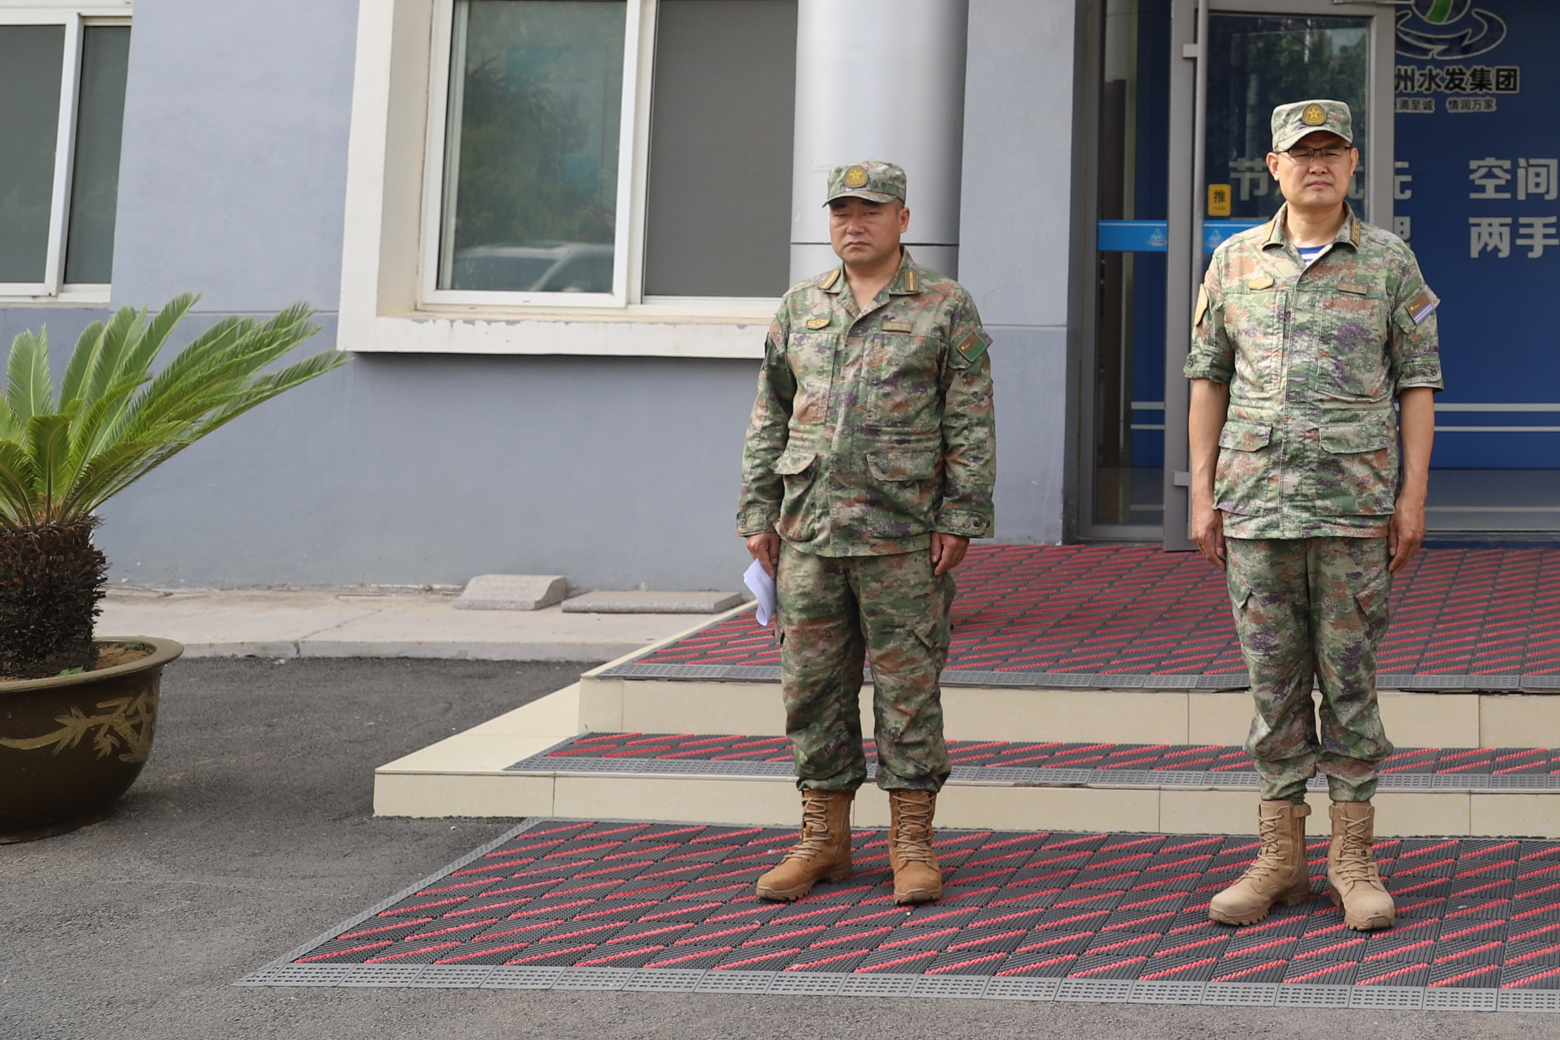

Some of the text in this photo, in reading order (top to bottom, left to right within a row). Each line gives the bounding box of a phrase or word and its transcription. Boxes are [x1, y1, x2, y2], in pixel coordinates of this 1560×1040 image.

[1395, 97, 1497, 112] 滴至诚 情润万家
[1213, 189, 1226, 203] 推
